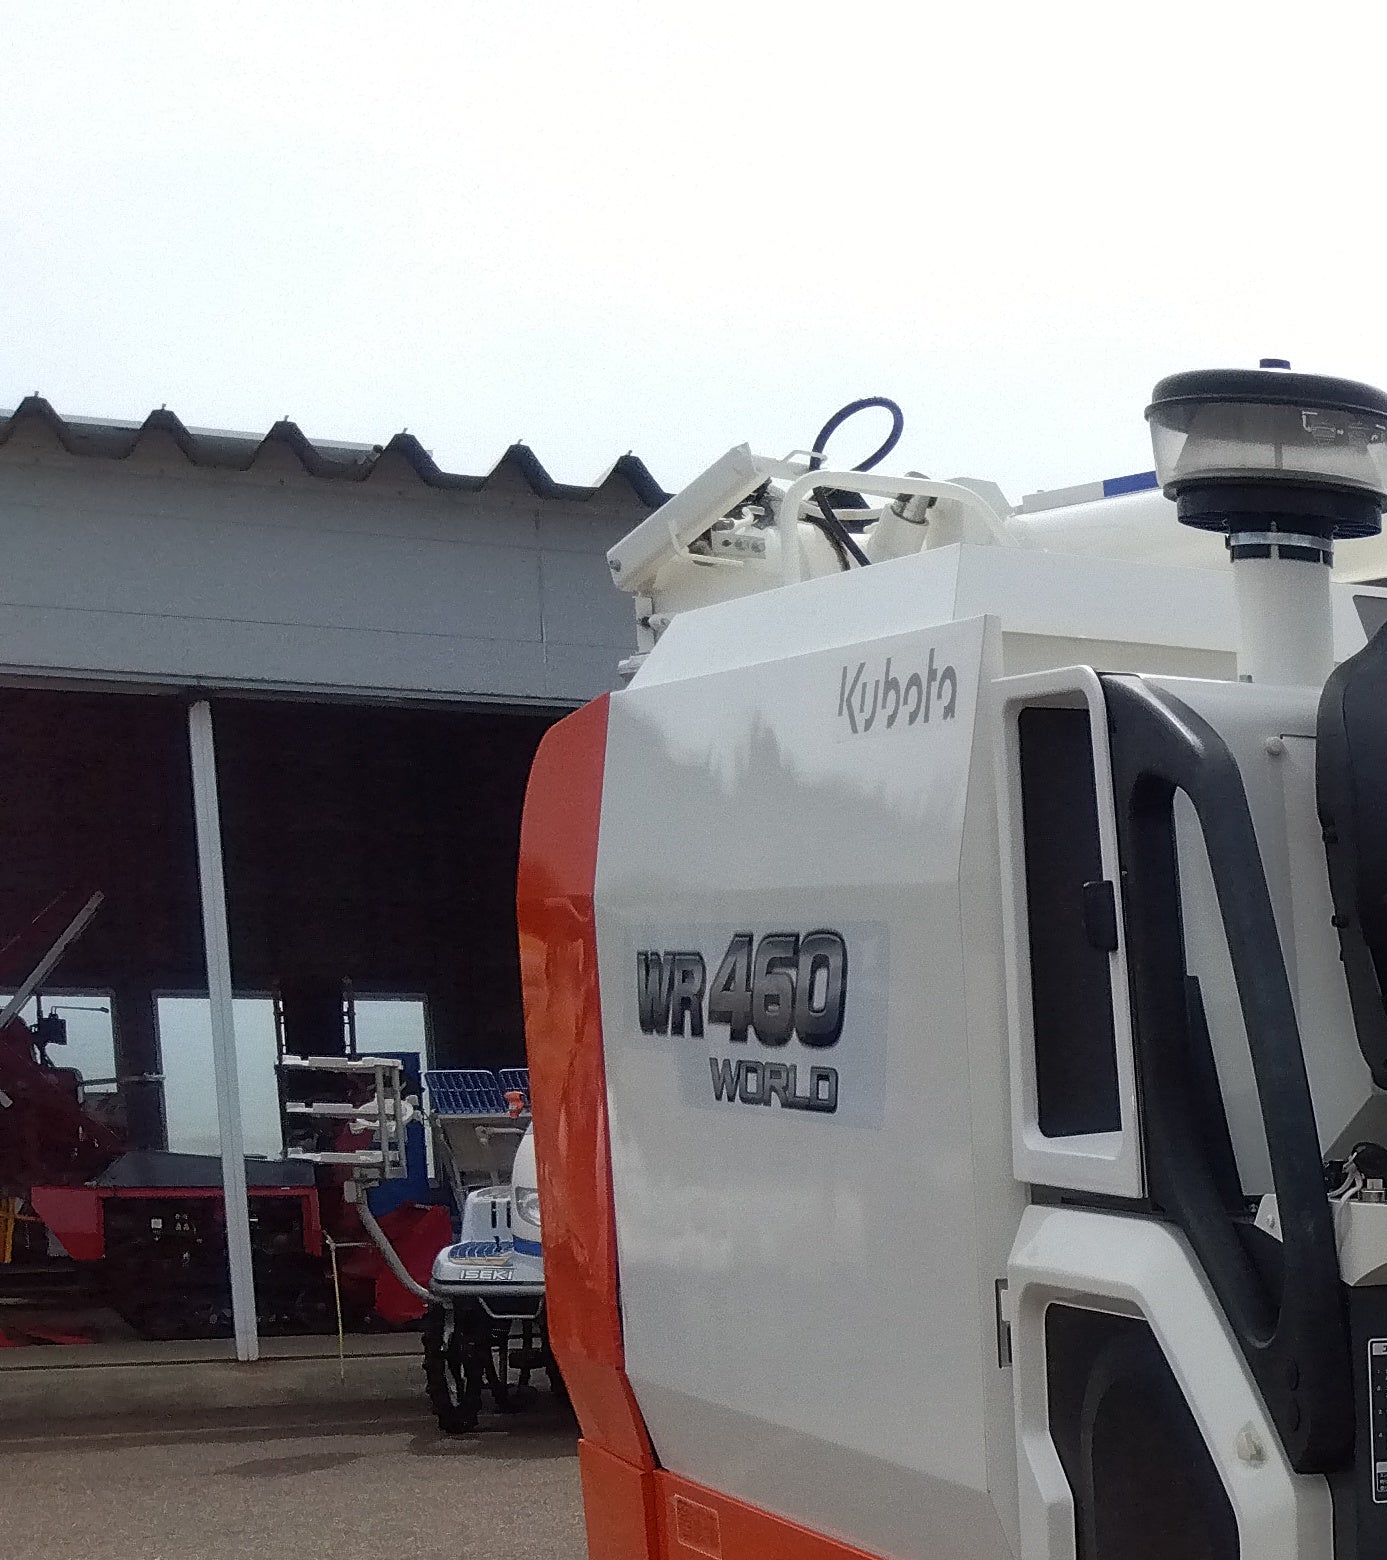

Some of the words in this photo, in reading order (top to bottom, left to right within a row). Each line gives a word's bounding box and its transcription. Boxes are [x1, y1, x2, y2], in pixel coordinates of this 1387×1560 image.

[837, 647, 957, 735] Kubota
[709, 1057, 839, 1113] WORLD
[459, 1269, 515, 1280] ISEKI
